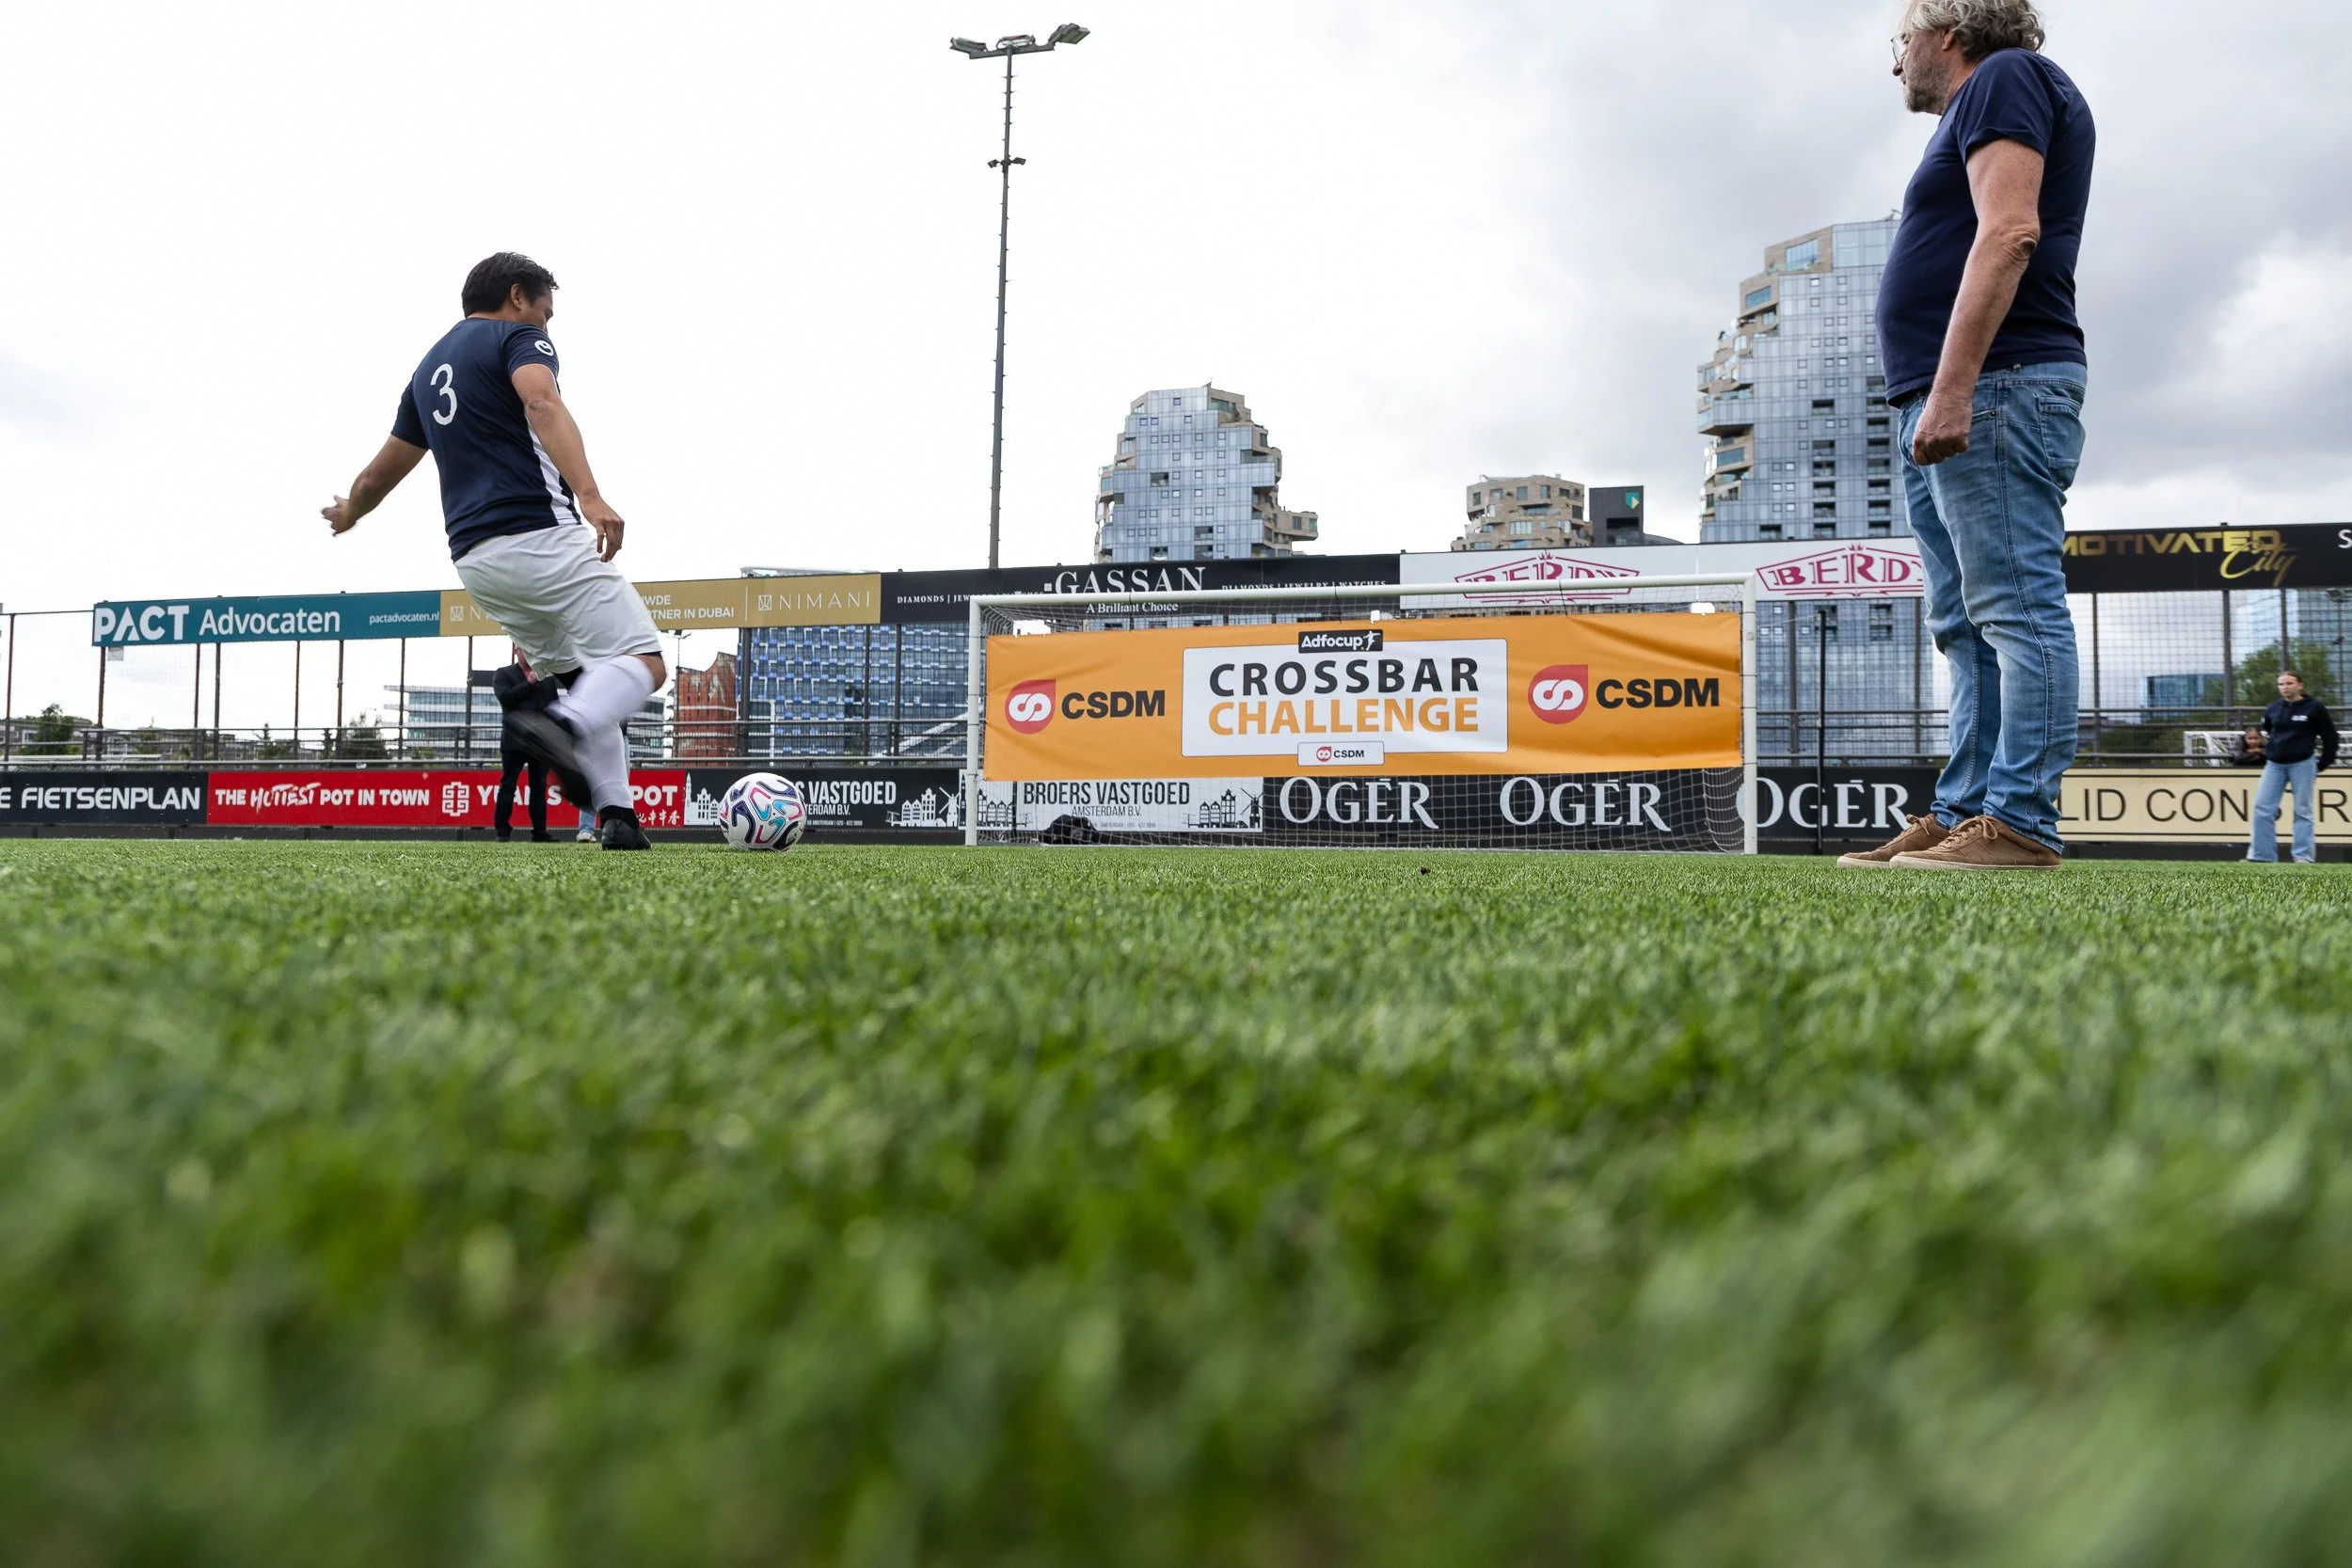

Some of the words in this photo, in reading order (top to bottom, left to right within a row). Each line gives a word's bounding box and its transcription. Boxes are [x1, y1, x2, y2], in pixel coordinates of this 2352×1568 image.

[430, 363, 458, 425] 3
[2219, 542, 2299, 587] City
[1055, 566, 1206, 594] GASSAN
[779, 591, 870, 610] NIMANI
[897, 595, 945, 604] DIAMONDS
[1086, 604, 1095, 613] A
[1098, 603, 1139, 613] Brilliant
[1141, 602, 1179, 611] Choice
[94, 605, 189, 641] PACT
[199, 607, 341, 636] Advocaten
[369, 611, 439, 626] pactadvocaten.nl
[684, 609, 695, 619] IN
[698, 607, 735, 619] DUBAI
[1209, 657, 1479, 697] CROSSBAR
[1061, 689, 1166, 720] CSDM
[1596, 677, 1720, 709] CSDM
[1209, 697, 1479, 736] CHALLENGE
[1333, 749, 1364, 758] CSDM
[21, 786, 200, 810] FIETSENPLAN
[215, 789, 246, 805] THE
[250, 782, 321, 816] HOTTEST
[320, 788, 354, 805] POT
[358, 788, 374, 805] IN
[379, 788, 430, 805] TOWN
[808, 781, 897, 805] VASTGOED
[1024, 782, 1091, 805] BROERS
[1096, 782, 1190, 805] VASTGOED
[2146, 788, 2351, 822] CONR
[836, 804, 850, 816] B.V.
[1072, 806, 1125, 816] AMSTERDAM
[1128, 806, 1142, 816] B.V.
